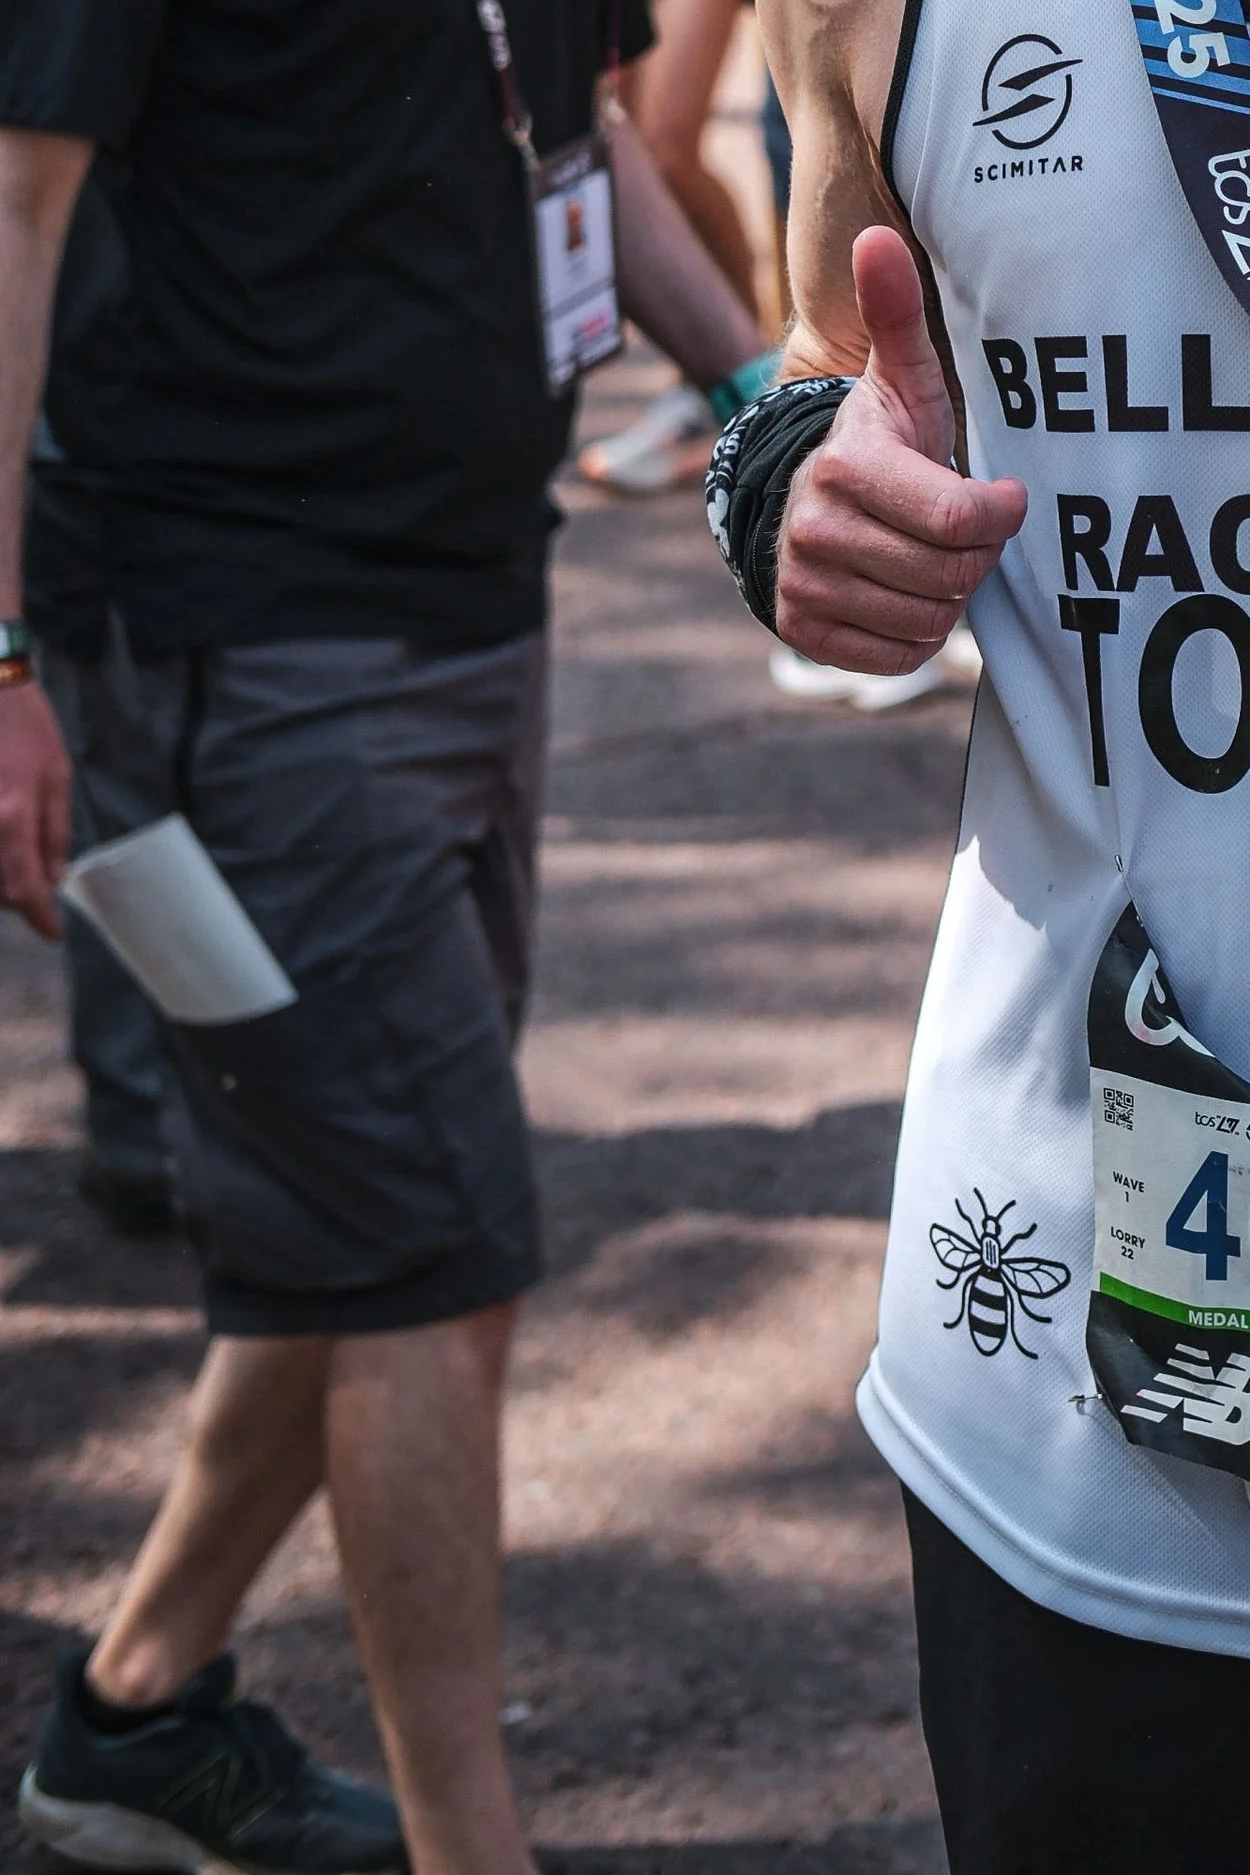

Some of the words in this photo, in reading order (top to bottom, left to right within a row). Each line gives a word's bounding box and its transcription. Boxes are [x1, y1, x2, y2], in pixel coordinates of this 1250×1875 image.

[973, 155, 1083, 183] SCIMITAR
[1112, 1171, 1145, 1193] WAVE
[1124, 1191, 1130, 1203] 1
[1110, 1226, 1146, 1249] LORRY
[1120, 1245, 1135, 1261] 22
[1187, 1309, 1249, 1329] MEDAL
